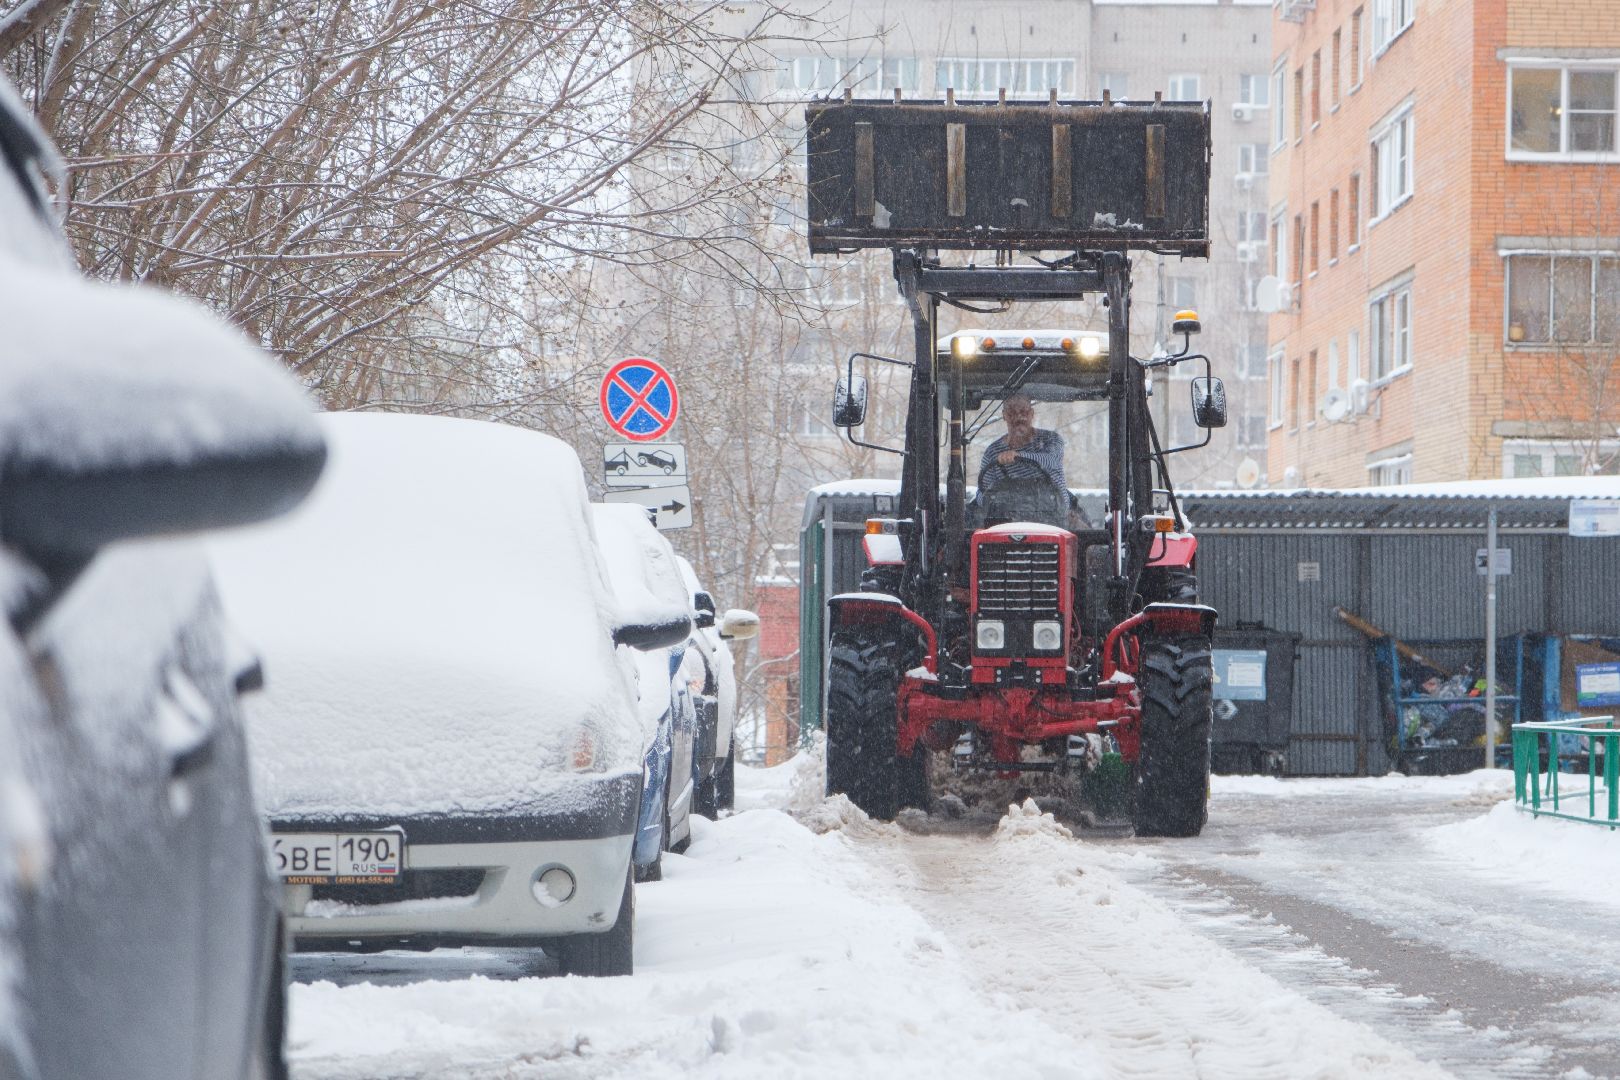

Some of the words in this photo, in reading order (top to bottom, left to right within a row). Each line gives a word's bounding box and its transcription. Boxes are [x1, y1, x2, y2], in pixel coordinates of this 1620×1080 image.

[342, 838, 389, 862] 190
[352, 864, 376, 873] RUS
[287, 876, 328, 885] MOTORS
